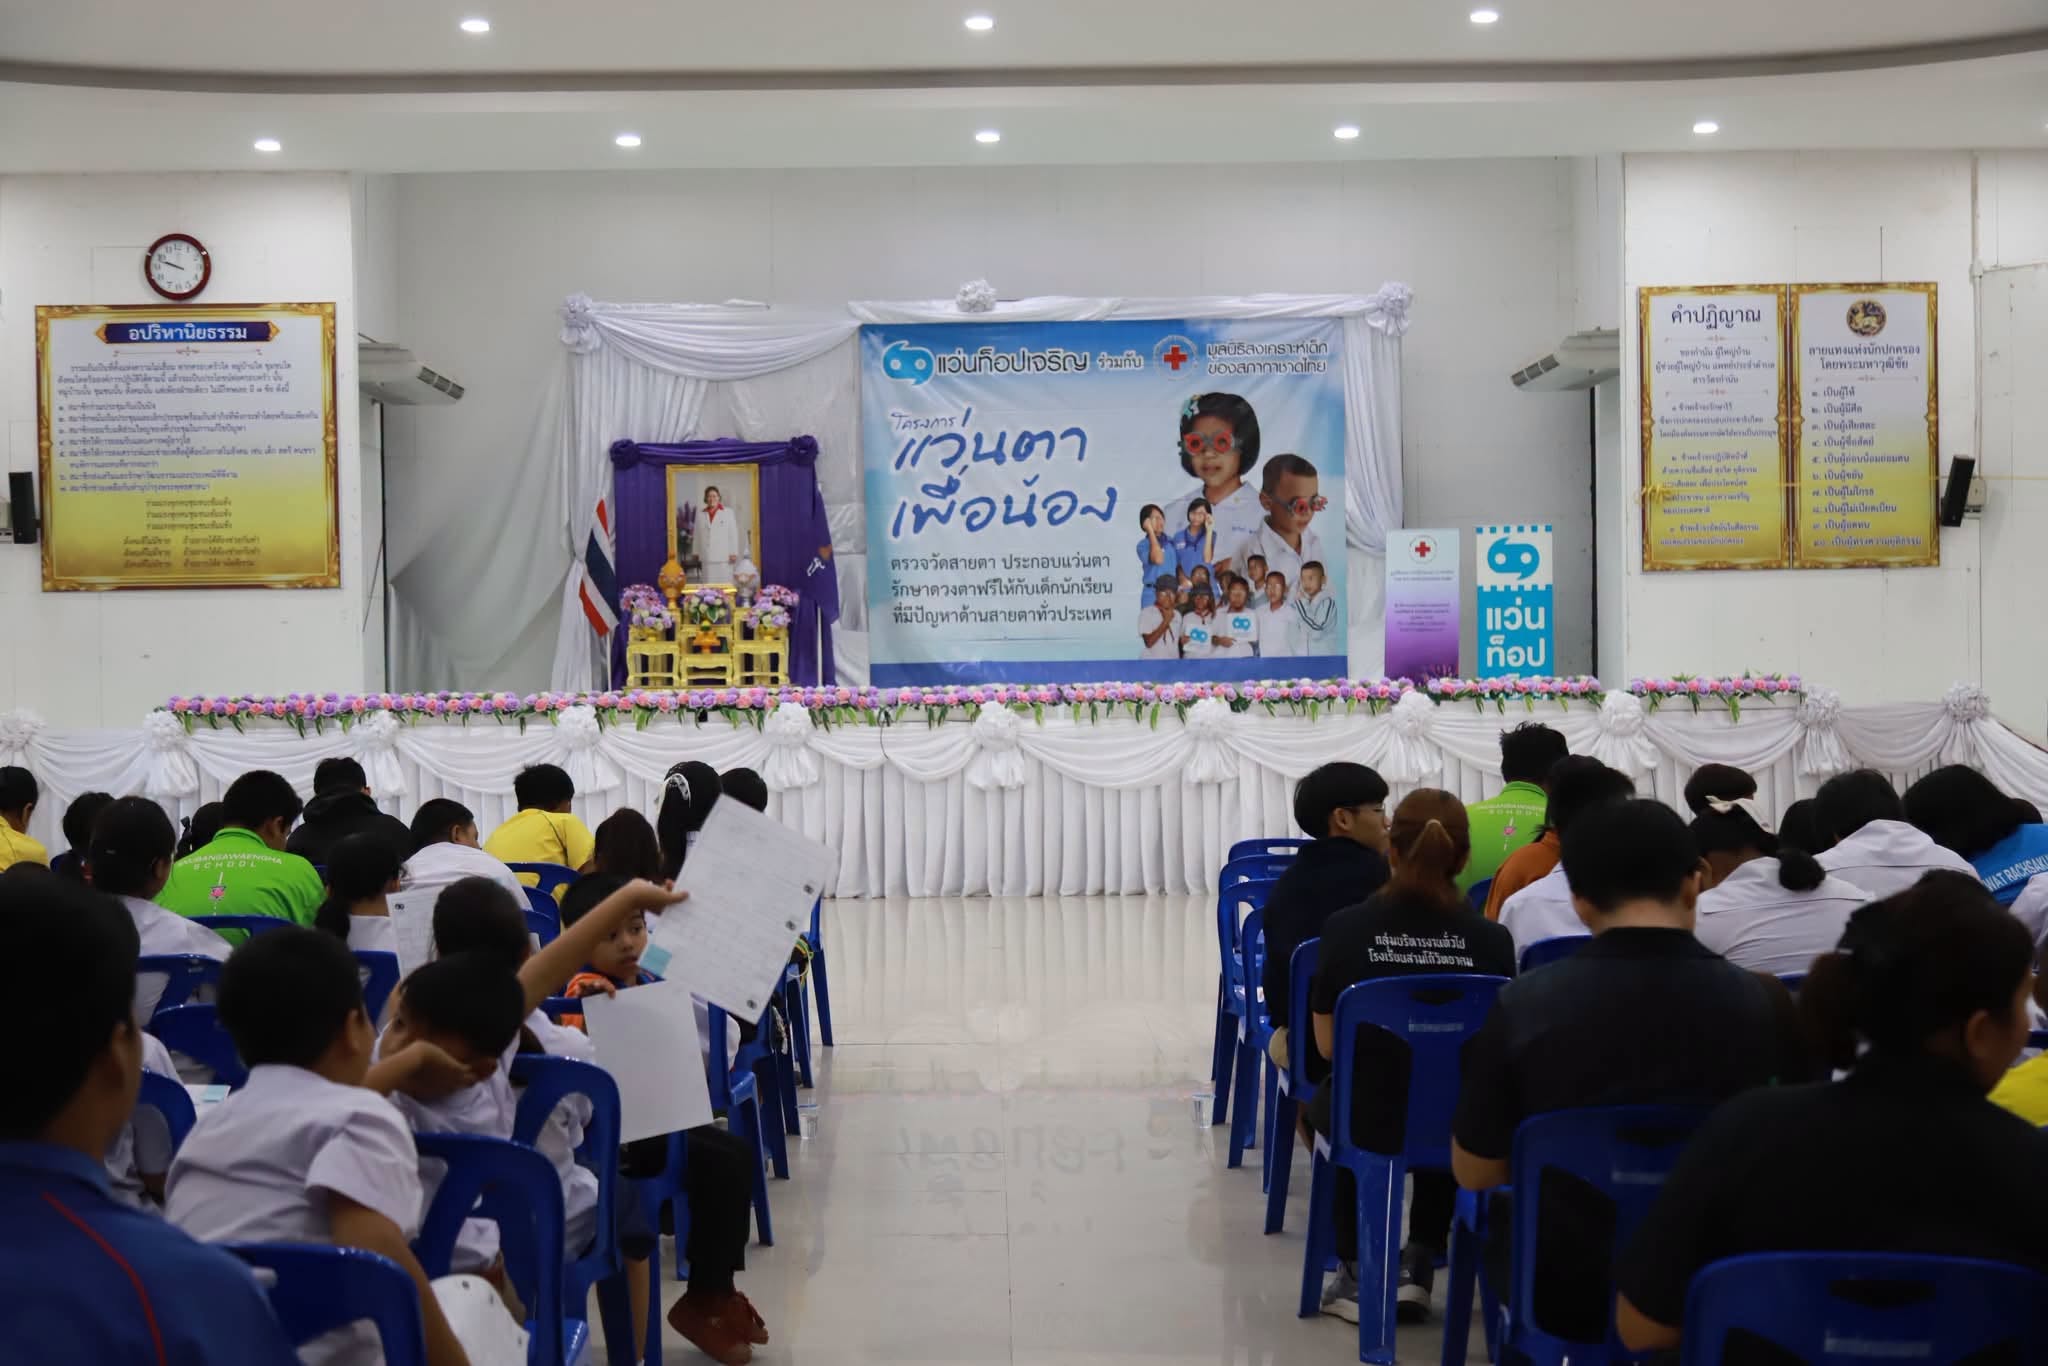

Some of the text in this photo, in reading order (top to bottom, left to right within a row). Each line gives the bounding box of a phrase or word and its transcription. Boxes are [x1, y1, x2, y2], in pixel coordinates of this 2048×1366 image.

[1671, 303, 1761, 330] คำปฏิญาณ
[937, 347, 1088, 374] แว่นท็อปเจริญ
[1097, 351, 1143, 369] ร่วมกับ
[1207, 339, 1328, 360] มูลนิธิสงเคราะห์เด็ก
[1207, 358, 1327, 375] ของสภากาชาดไทย
[890, 412, 956, 431] โครงการ
[895, 407, 1088, 470] แว่นตา
[892, 465, 1118, 538] เพื่อน้อง
[891, 552, 1111, 571] ตรวจวัดสายตา ประกอบแว่นตา
[891, 576, 1113, 598] รักษาดวงตาฟรีให้กับเด็กนักเรียน
[892, 600, 1112, 629] ที่มีปัญหาด้านสายตาทั่วประเทศ
[1486, 597, 1545, 631] แว่น
[1486, 634, 1546, 668] ท็อป
[193, 860, 257, 870] SCHOOL
